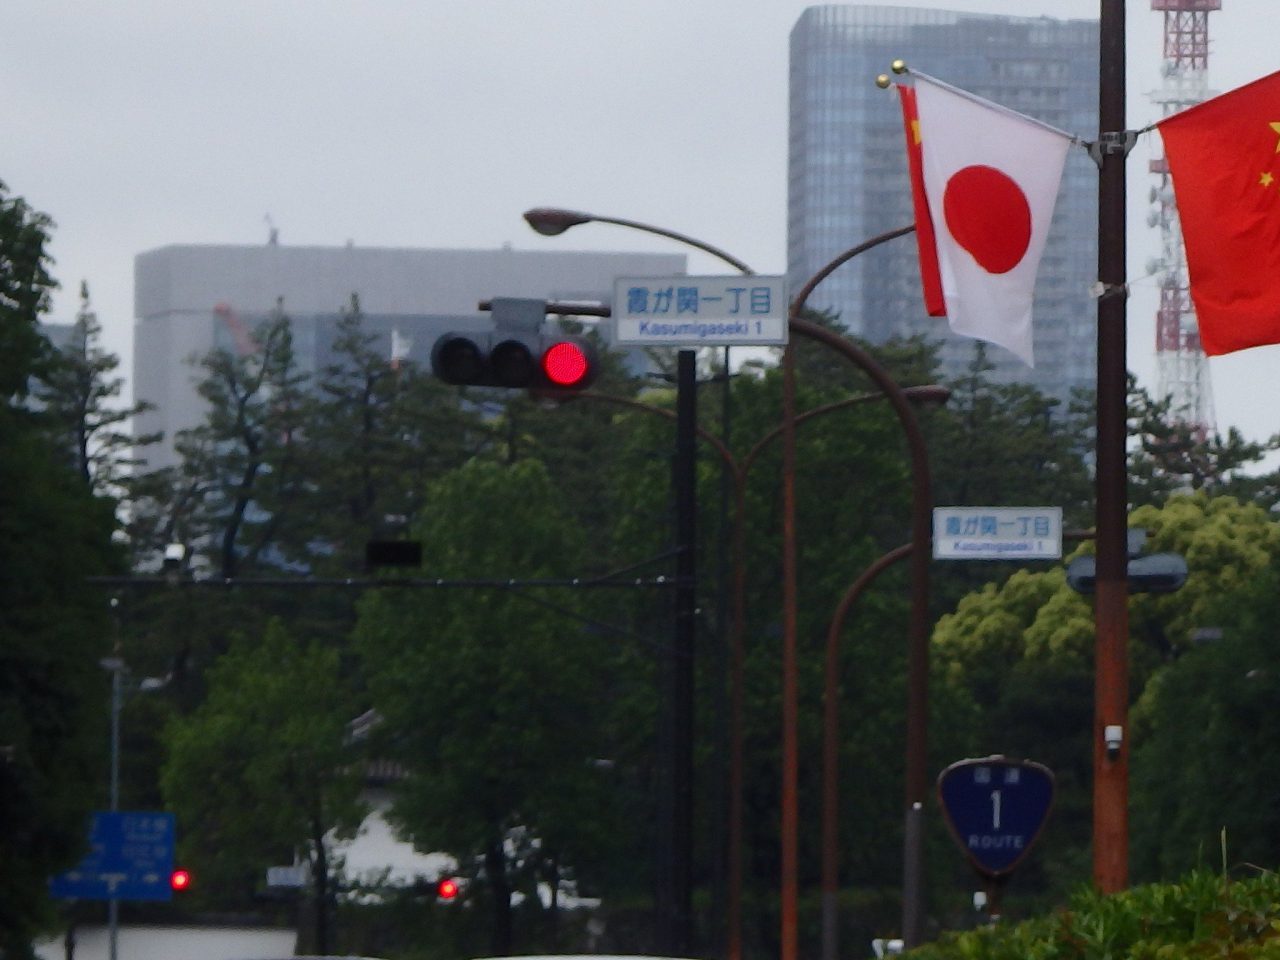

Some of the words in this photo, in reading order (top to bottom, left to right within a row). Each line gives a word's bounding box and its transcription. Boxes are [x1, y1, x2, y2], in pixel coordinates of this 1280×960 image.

[628, 286, 771, 314] 霞が関一丁目
[639, 321, 748, 337] Kasumigaseki
[755, 321, 763, 334] 1
[990, 790, 1001, 829] 1
[968, 834, 1024, 849] ROUTE
